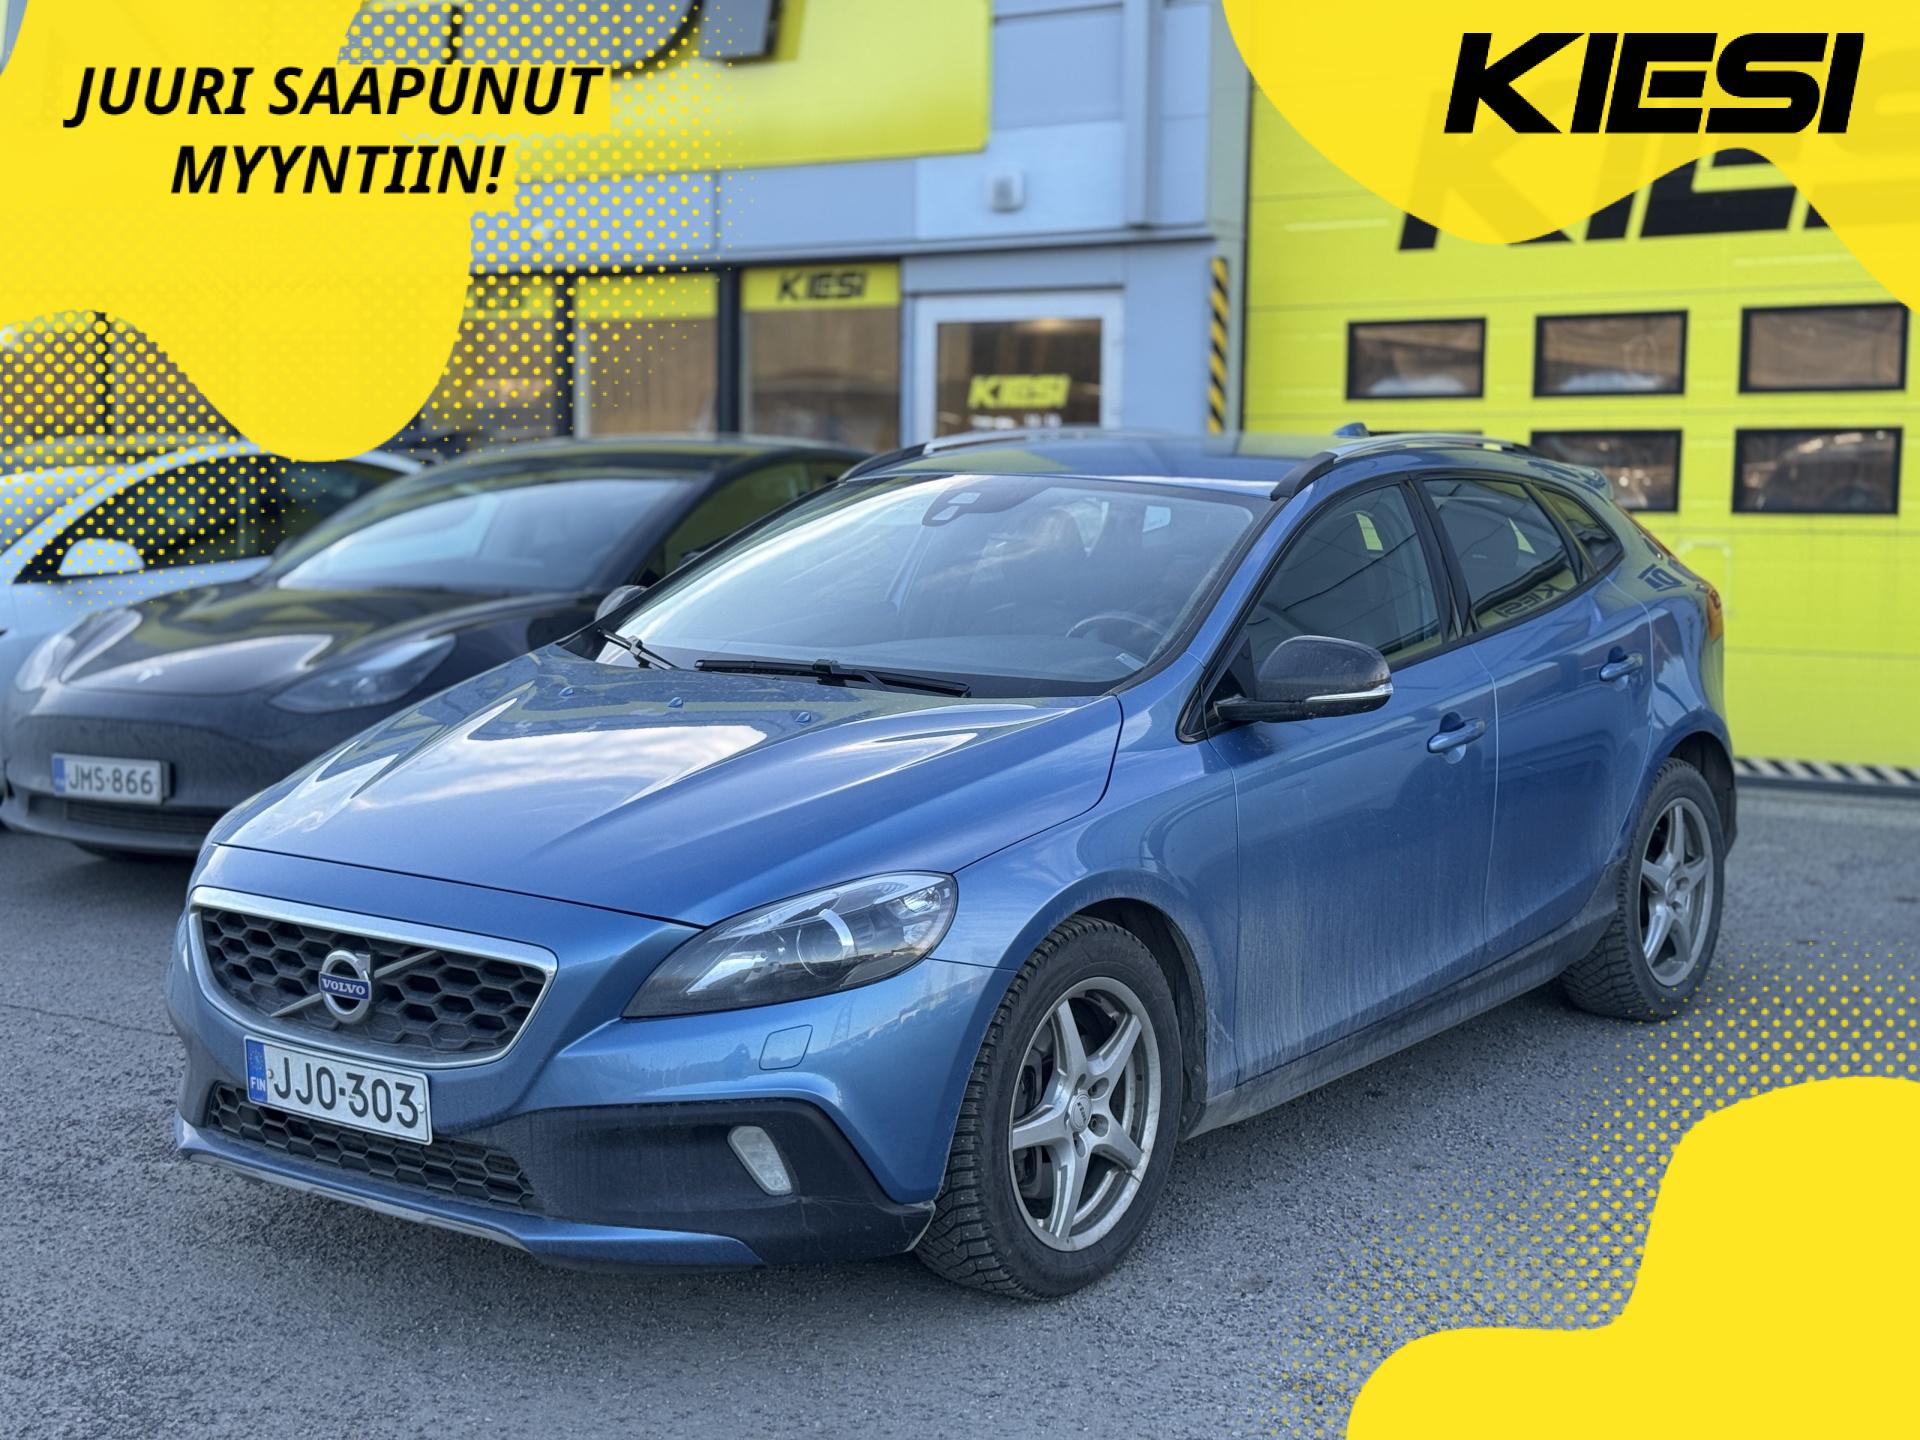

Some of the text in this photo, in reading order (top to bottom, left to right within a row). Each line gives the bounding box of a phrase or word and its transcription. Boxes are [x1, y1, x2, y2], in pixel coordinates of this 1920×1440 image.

[777, 271, 868, 301] KIESI
[967, 374, 1072, 409] KIESI
[321, 978, 366, 995] VOLVO
[250, 1076, 266, 1092] FIN
